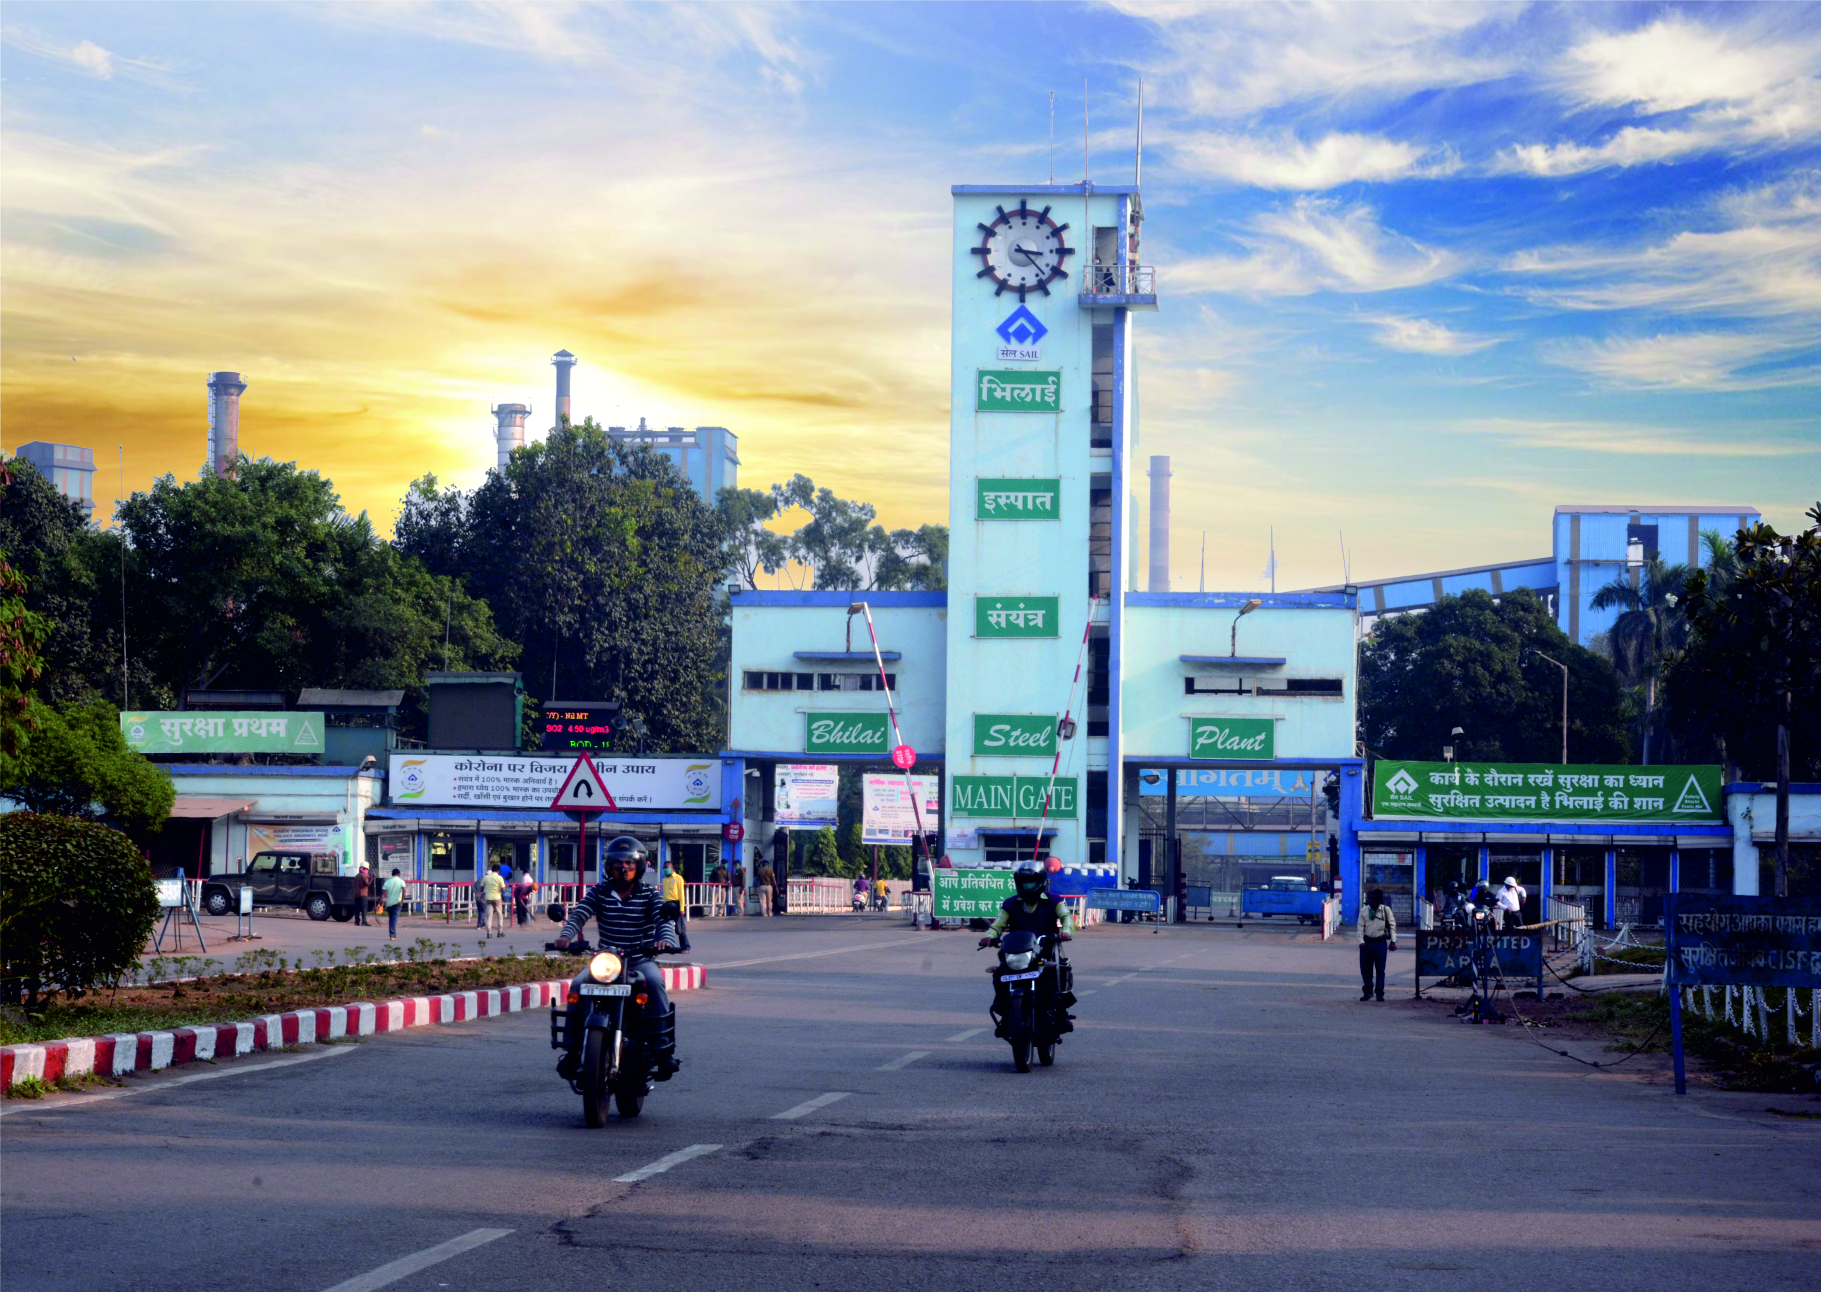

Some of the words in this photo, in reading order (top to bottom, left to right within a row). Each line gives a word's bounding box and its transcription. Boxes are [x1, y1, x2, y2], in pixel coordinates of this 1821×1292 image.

[1000, 348, 1017, 359] सेल
[1020, 350, 1039, 359] SAIL
[980, 376, 1058, 407] भिलाई
[983, 492, 1054, 514] इस्पात
[987, 602, 1046, 629] संयंत्र
[565, 712, 576, 720] Nil
[576, 712, 589, 720] MT
[160, 718, 226, 746] सुरक्षा
[232, 718, 288, 738] प्रथम
[546, 724, 564, 732] SO2
[811, 720, 885, 744] Bhilai
[984, 724, 1051, 746] Steel
[1195, 725, 1266, 751] Plant
[454, 759, 503, 772] कोरोना
[508, 762, 525, 772] पर
[530, 761, 568, 774] विजय
[622, 764, 656, 774] उपाय
[896, 750, 904, 764] STOP
[458, 774, 472, 782] संयंत्र
[522, 777, 547, 785] अनिवार्य
[542, 786, 561, 794] उपयो
[1430, 767, 1461, 786] कार्य
[1484, 768, 1524, 786] दौरान
[1528, 769, 1554, 786] रखें
[1558, 774, 1600, 792] सुरक्षा
[1604, 776, 1625, 788] का
[1629, 775, 1665, 788] ध्यान
[502, 795, 520, 803] बुखार
[522, 794, 532, 802] होने
[619, 794, 635, 802] संपर्क
[637, 794, 648, 803] करें
[954, 784, 1012, 810] MAIN
[1019, 785, 1074, 810] GATE
[1429, 790, 1481, 812] सुरक्षित
[1484, 795, 1537, 808] उत्पादन
[1540, 790, 1550, 809] है
[1555, 791, 1604, 812] भिलाई
[1608, 791, 1630, 810] की
[1634, 797, 1665, 810] शान
[939, 877, 959, 889] आप
[960, 874, 1004, 890] प्रतिबंधित
[942, 895, 951, 910] में
[954, 896, 976, 912] प्रवेश
[978, 901, 993, 912] कर
[1678, 908, 1732, 936] सहयोग
